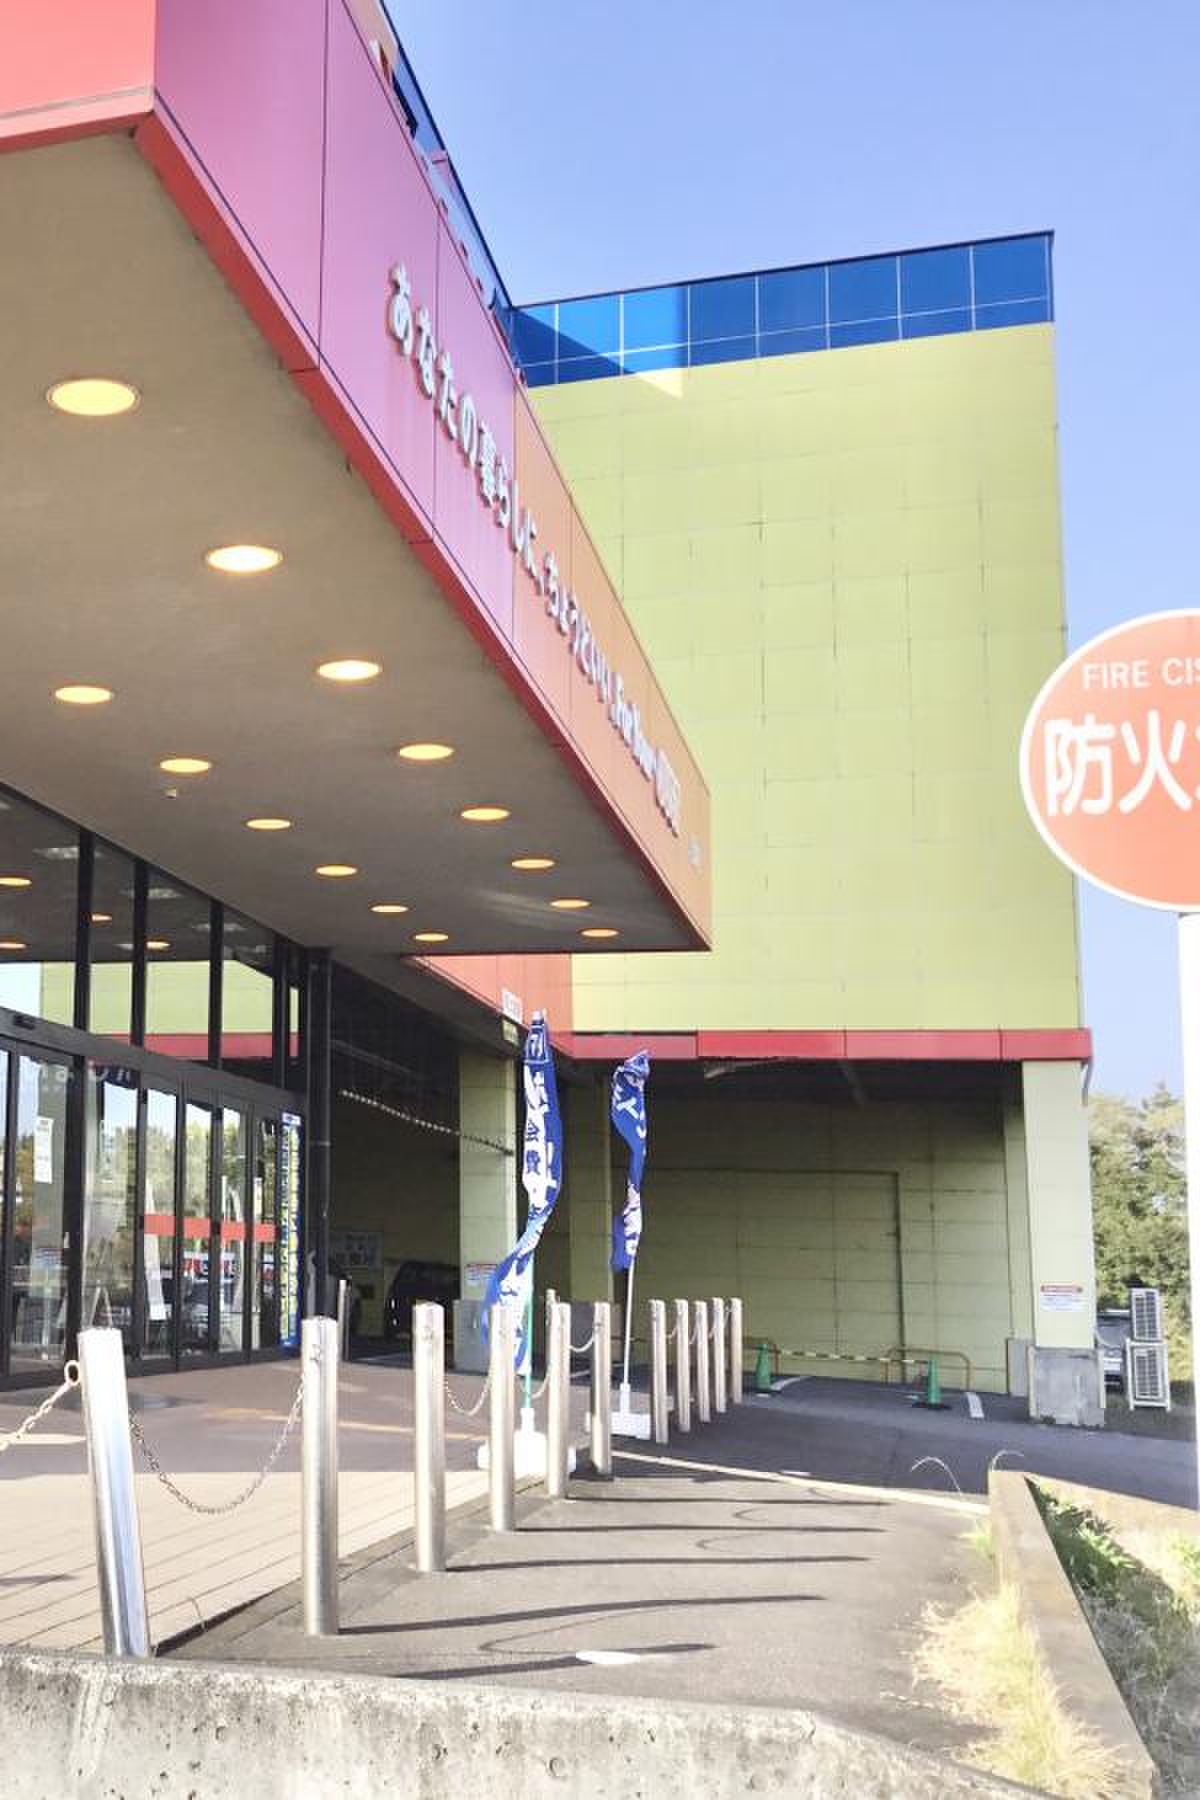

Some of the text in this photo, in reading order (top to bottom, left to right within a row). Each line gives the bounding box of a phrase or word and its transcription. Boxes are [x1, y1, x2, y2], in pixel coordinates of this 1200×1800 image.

[1083, 656, 1200, 690] FIRE CI
[1044, 709, 1200, 817] 防火
